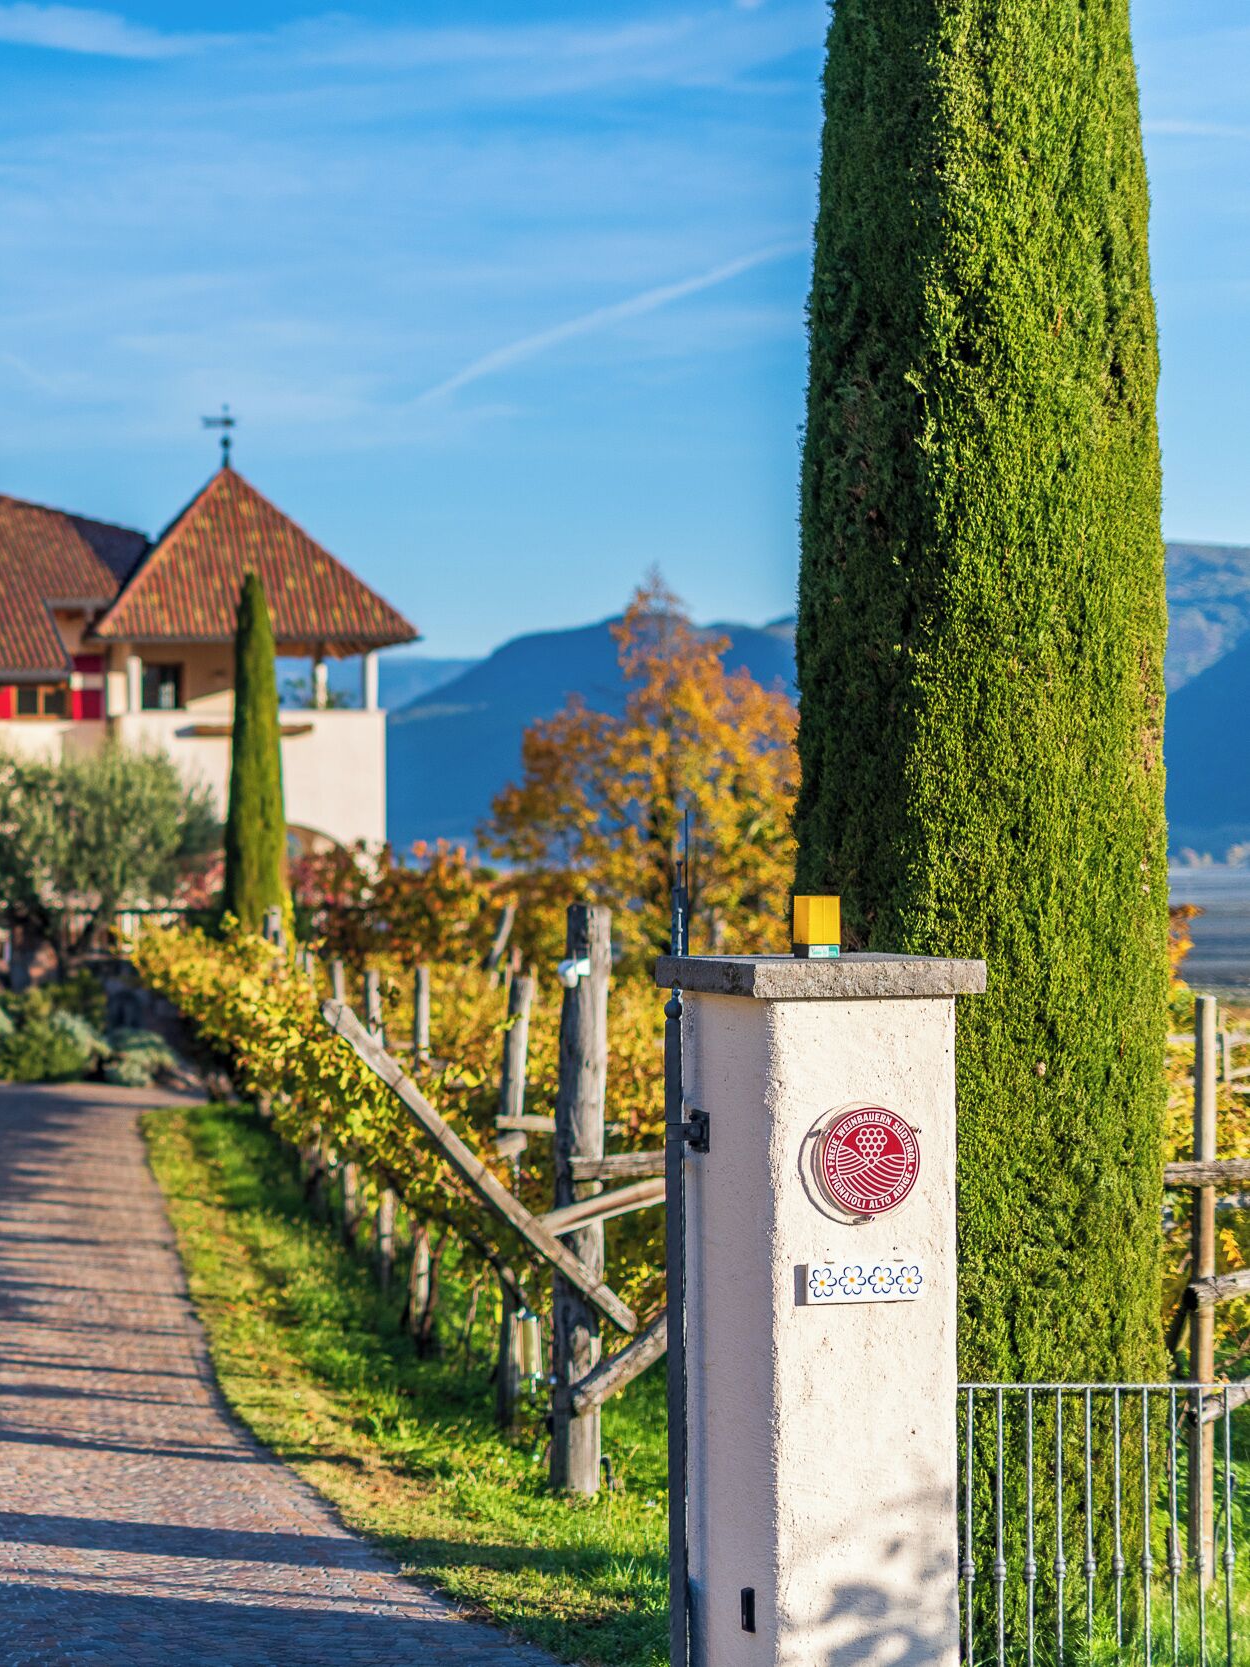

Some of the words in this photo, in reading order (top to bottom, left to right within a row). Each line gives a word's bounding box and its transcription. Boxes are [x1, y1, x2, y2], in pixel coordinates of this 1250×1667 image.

[827, 1138, 840, 1166] FREIE
[837, 1113, 893, 1138] WEINBAUERN
[892, 1121, 915, 1164] SÜDTIROL
[828, 1173, 866, 1209] VIGNAIOLI
[869, 1195, 892, 1209] ALTO
[894, 1171, 913, 1199] ADIGE
